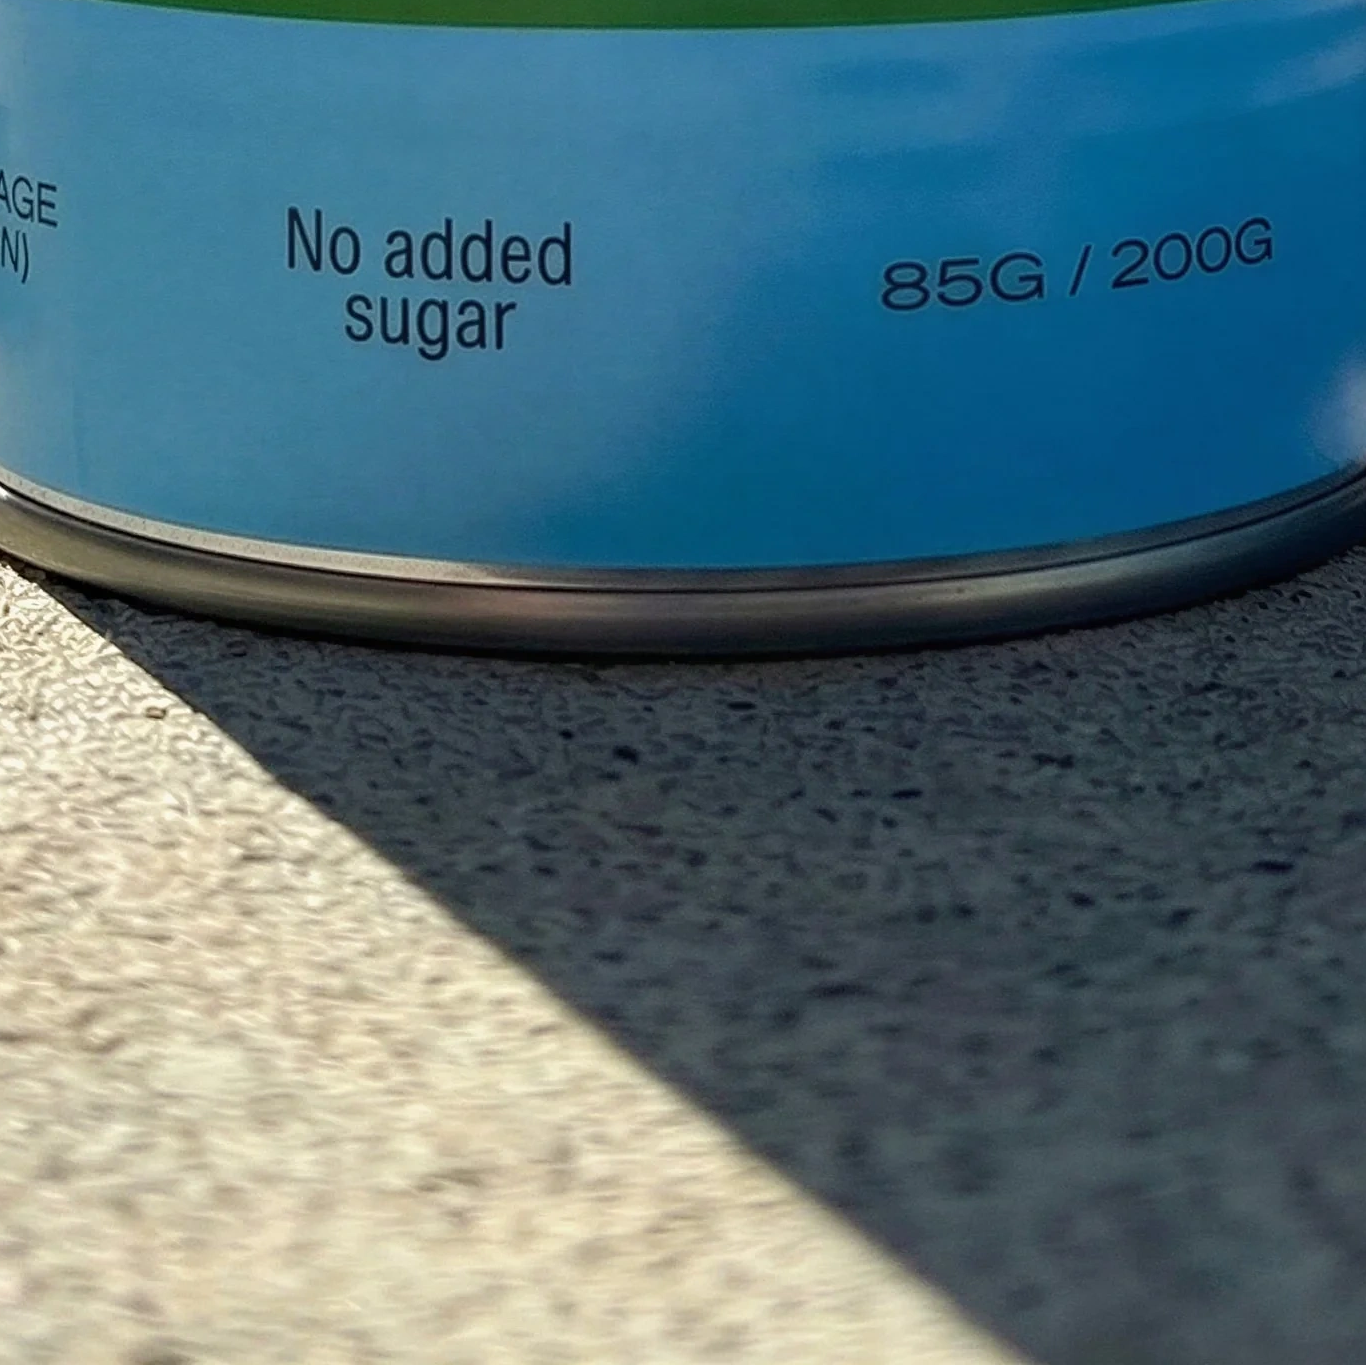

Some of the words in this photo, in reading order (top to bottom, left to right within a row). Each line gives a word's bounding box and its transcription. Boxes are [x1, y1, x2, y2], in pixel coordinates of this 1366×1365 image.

[287, 205, 361, 276] No
[384, 217, 572, 286] added
[881, 251, 1045, 312] 85G
[1069, 244, 1094, 298] /
[1110, 215, 1274, 291] 200G
[344, 293, 518, 362] sugar
